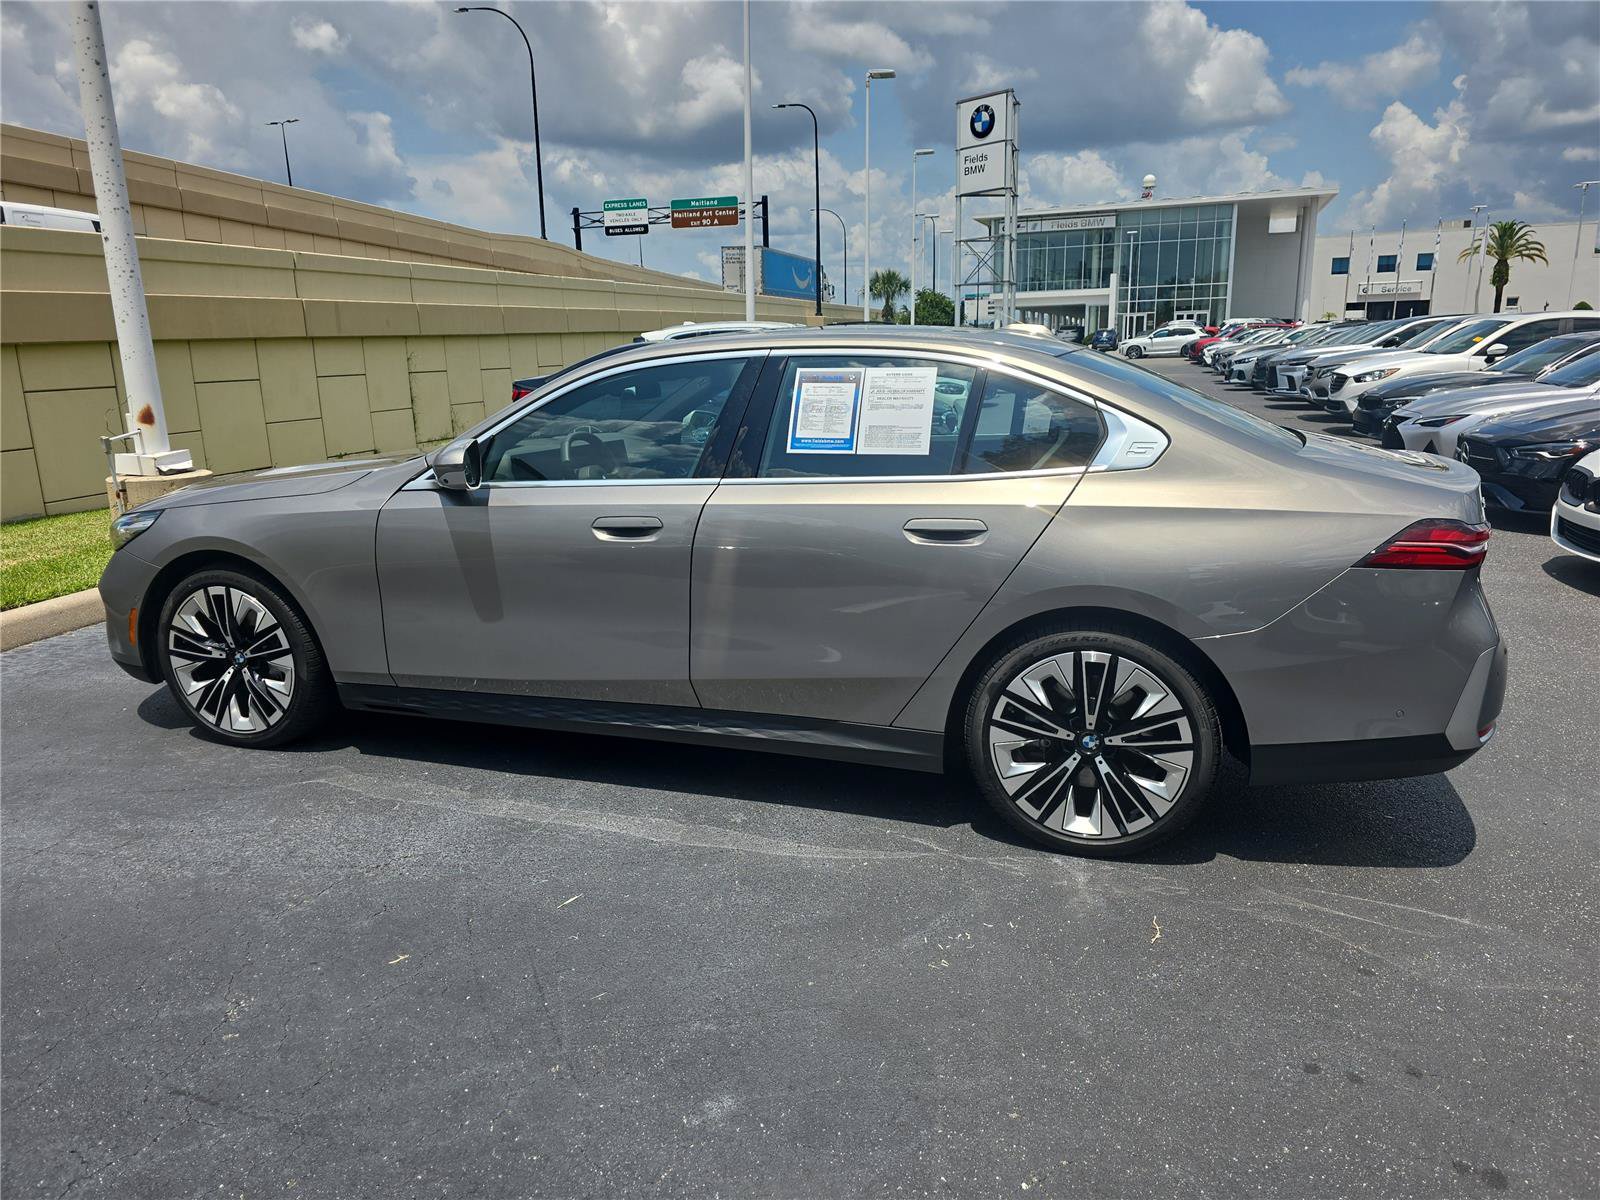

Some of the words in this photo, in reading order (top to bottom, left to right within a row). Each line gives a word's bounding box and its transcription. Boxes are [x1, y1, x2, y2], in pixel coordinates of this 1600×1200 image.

[964, 153, 988, 164] Fields
[964, 164, 986, 176] BMW
[1051, 220, 1078, 229] Fields
[1080, 218, 1106, 227] BMW
[1126, 441, 1158, 458] 5
